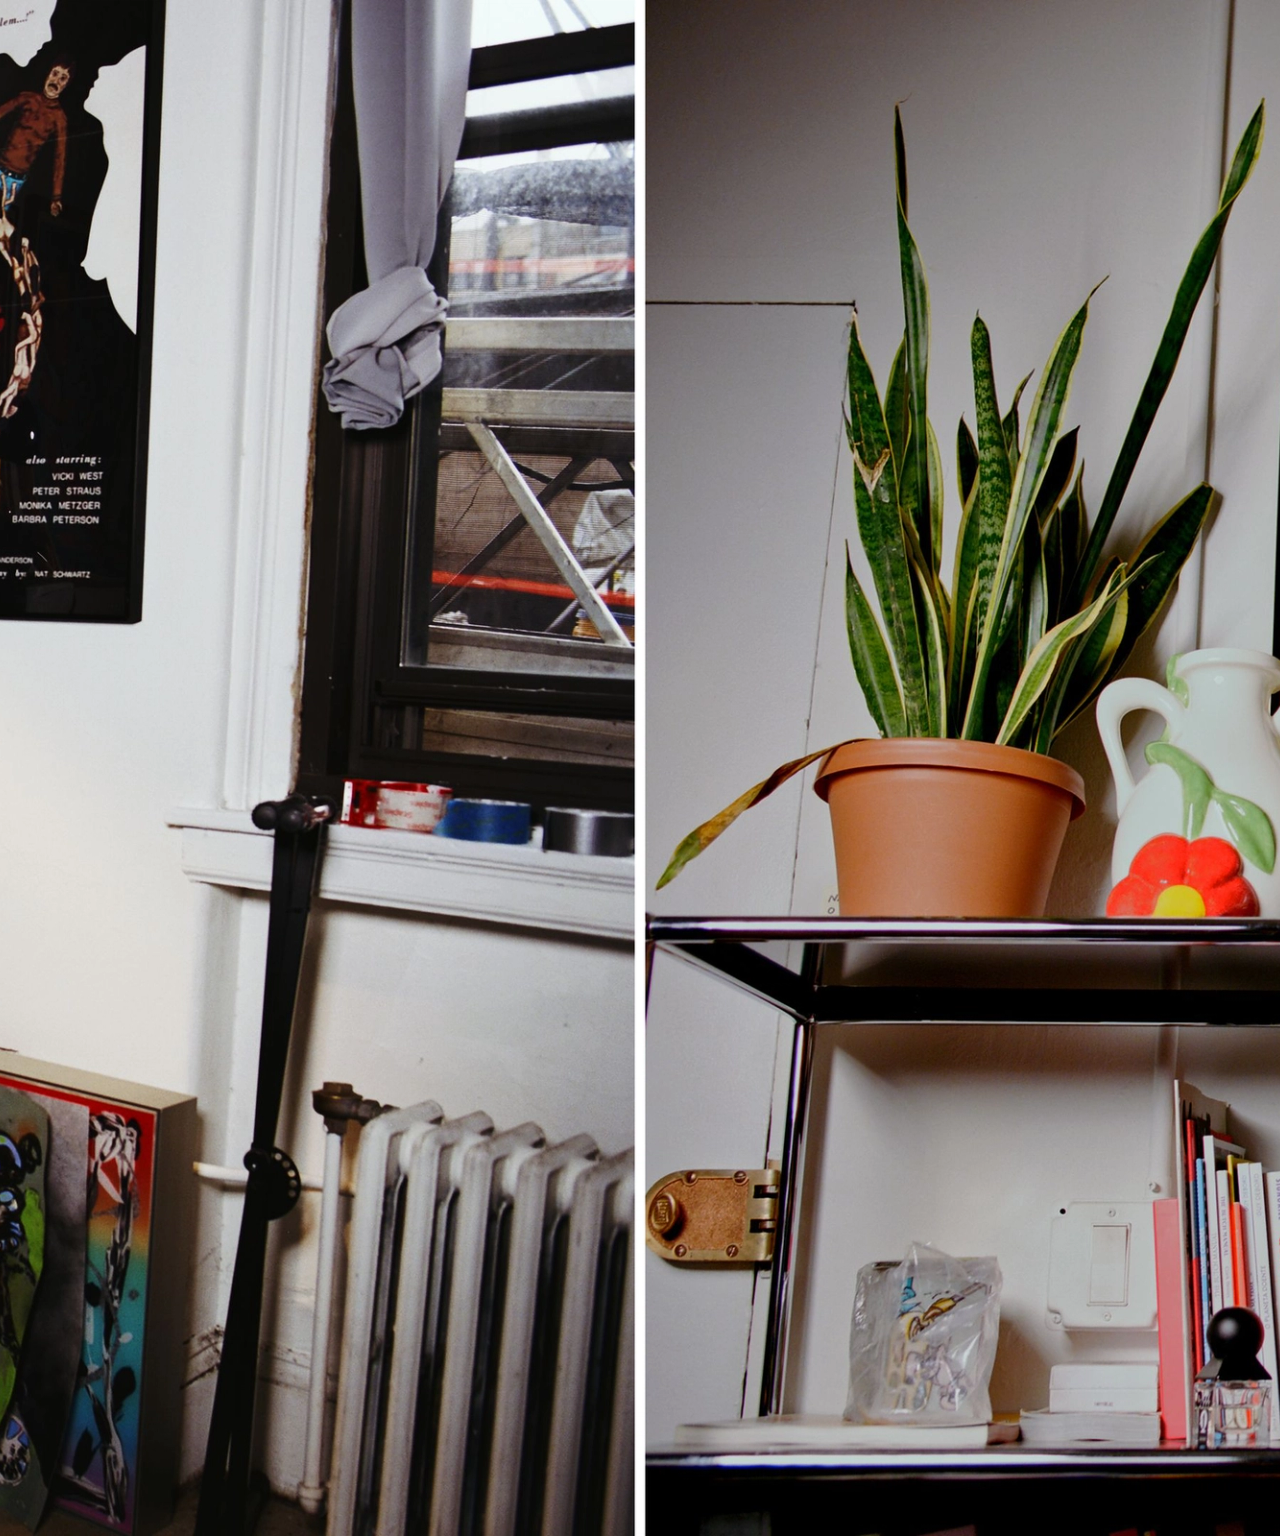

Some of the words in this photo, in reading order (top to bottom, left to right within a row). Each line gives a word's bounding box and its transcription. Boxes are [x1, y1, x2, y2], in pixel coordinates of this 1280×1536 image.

[25, 455, 46, 464] also
[55, 454, 102, 467] starring:
[52, 472, 74, 481] VICKI
[79, 471, 104, 480] WEST
[32, 487, 60, 495] PETER
[66, 486, 102, 495] STRAUS
[19, 501, 52, 510] MONIKA
[58, 501, 101, 510] METZGER
[12, 515, 47, 524] BARBRA
[52, 515, 100, 524] PETERSON
